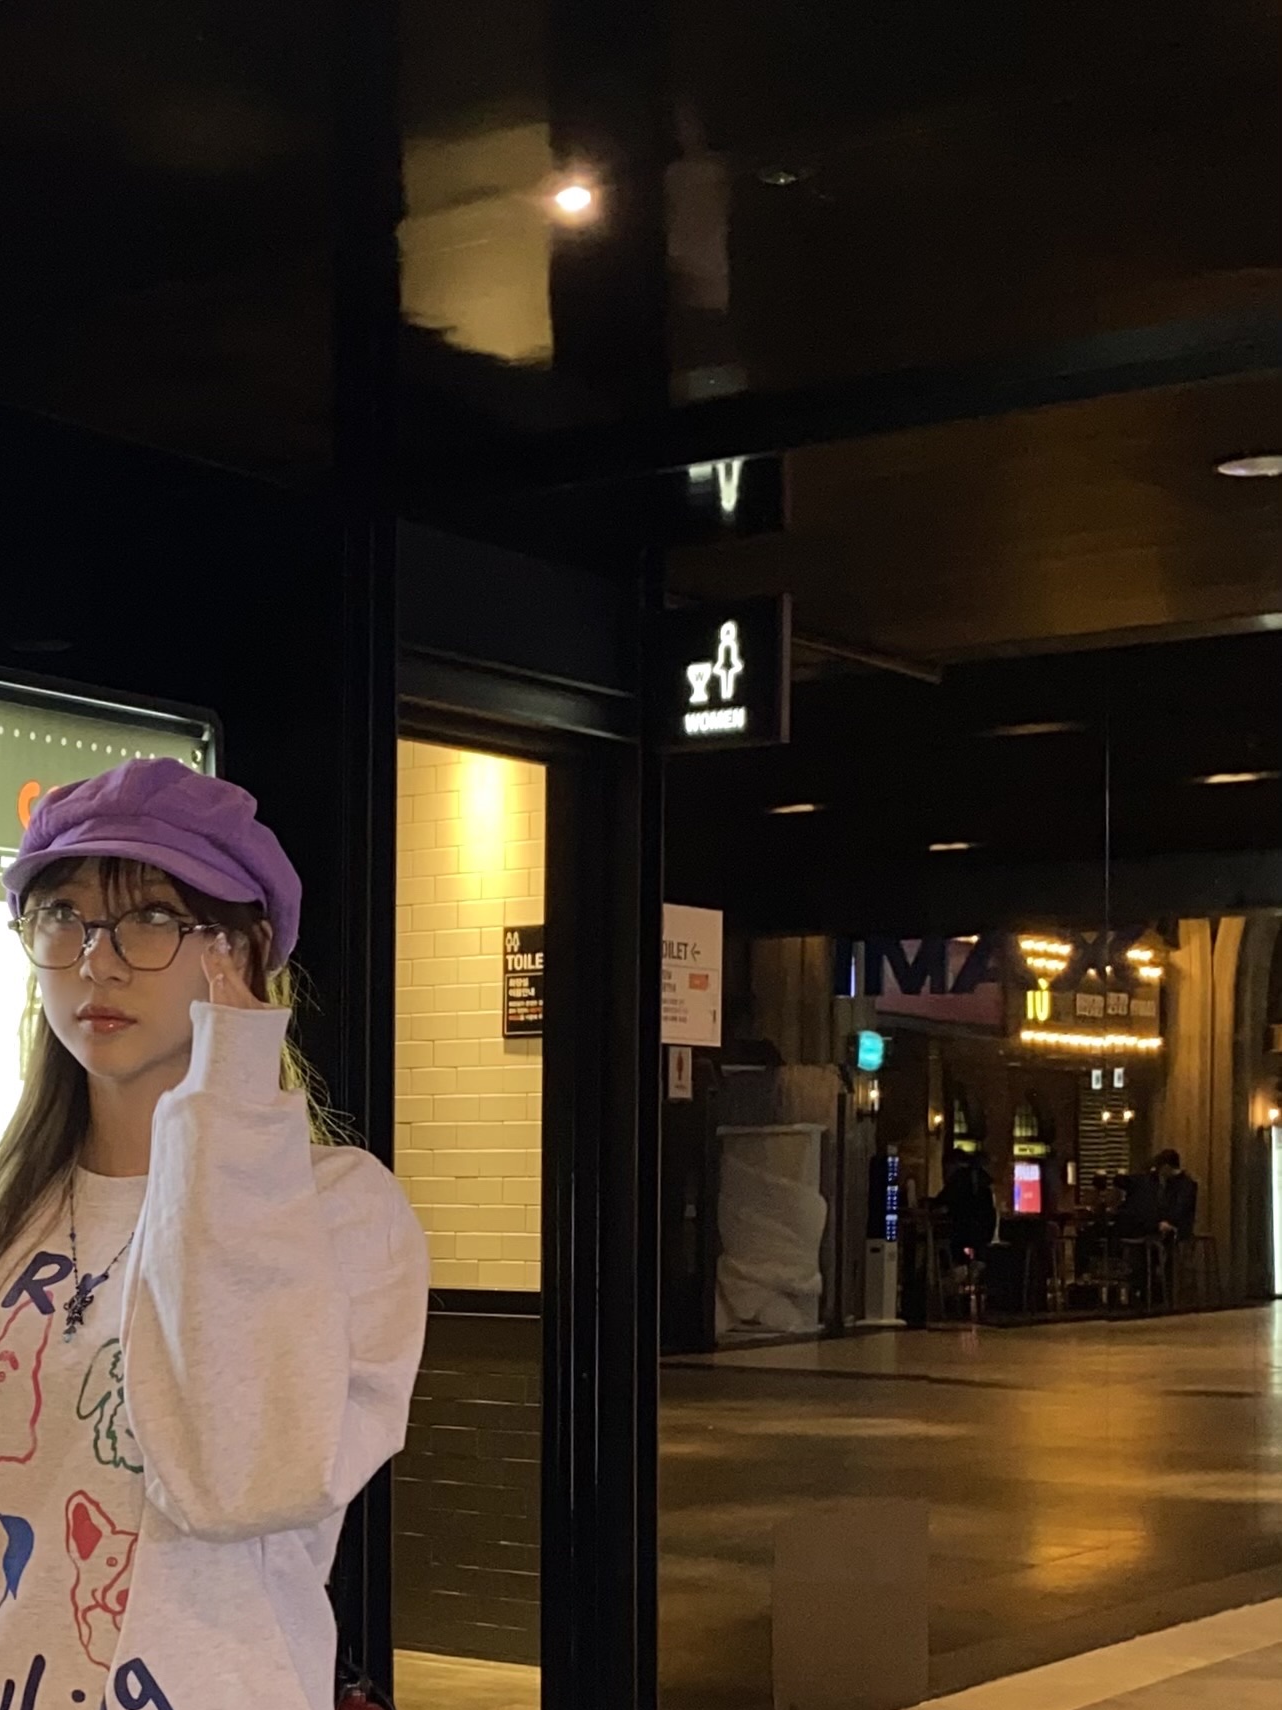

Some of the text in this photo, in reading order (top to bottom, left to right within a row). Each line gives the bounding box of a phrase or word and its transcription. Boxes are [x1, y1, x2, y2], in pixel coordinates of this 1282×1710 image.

[684, 705, 746, 734] WOMEN
[662, 940, 689, 960] OILET
[505, 952, 545, 971] TOILE
